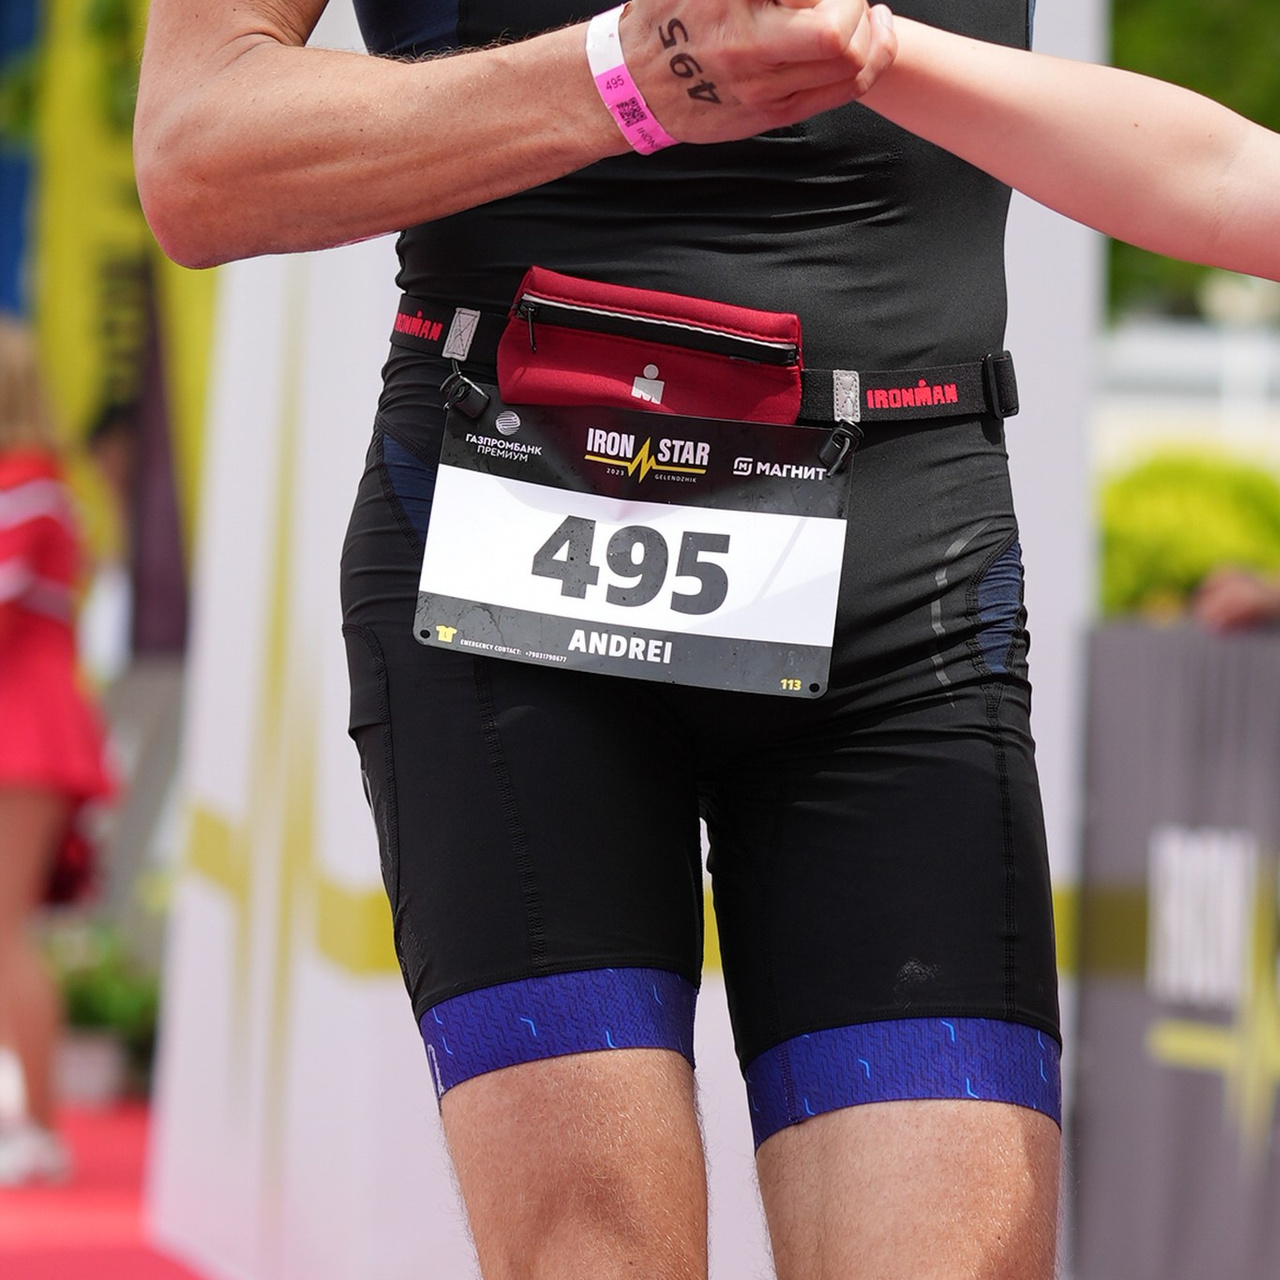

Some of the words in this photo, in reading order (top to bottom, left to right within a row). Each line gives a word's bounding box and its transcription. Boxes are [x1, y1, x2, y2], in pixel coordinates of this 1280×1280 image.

[658, 17, 723, 105] 495
[605, 74, 626, 91] 495
[866, 379, 959, 409] IRONMAN
[465, 432, 543, 456] ГАЗПРОМБАНК
[476, 445, 529, 463] ПРЕМИУМ
[586, 427, 635, 458] IRON
[657, 438, 710, 466] STAR
[606, 467, 625, 477] 2023
[654, 474, 697, 484] GELENDZHIK
[756, 461, 827, 481] МАГНИТ
[531, 515, 731, 616] 495
[460, 639, 494, 650] EMERGENCY
[567, 629, 673, 664] ANDREI
[780, 678, 802, 691] 113
